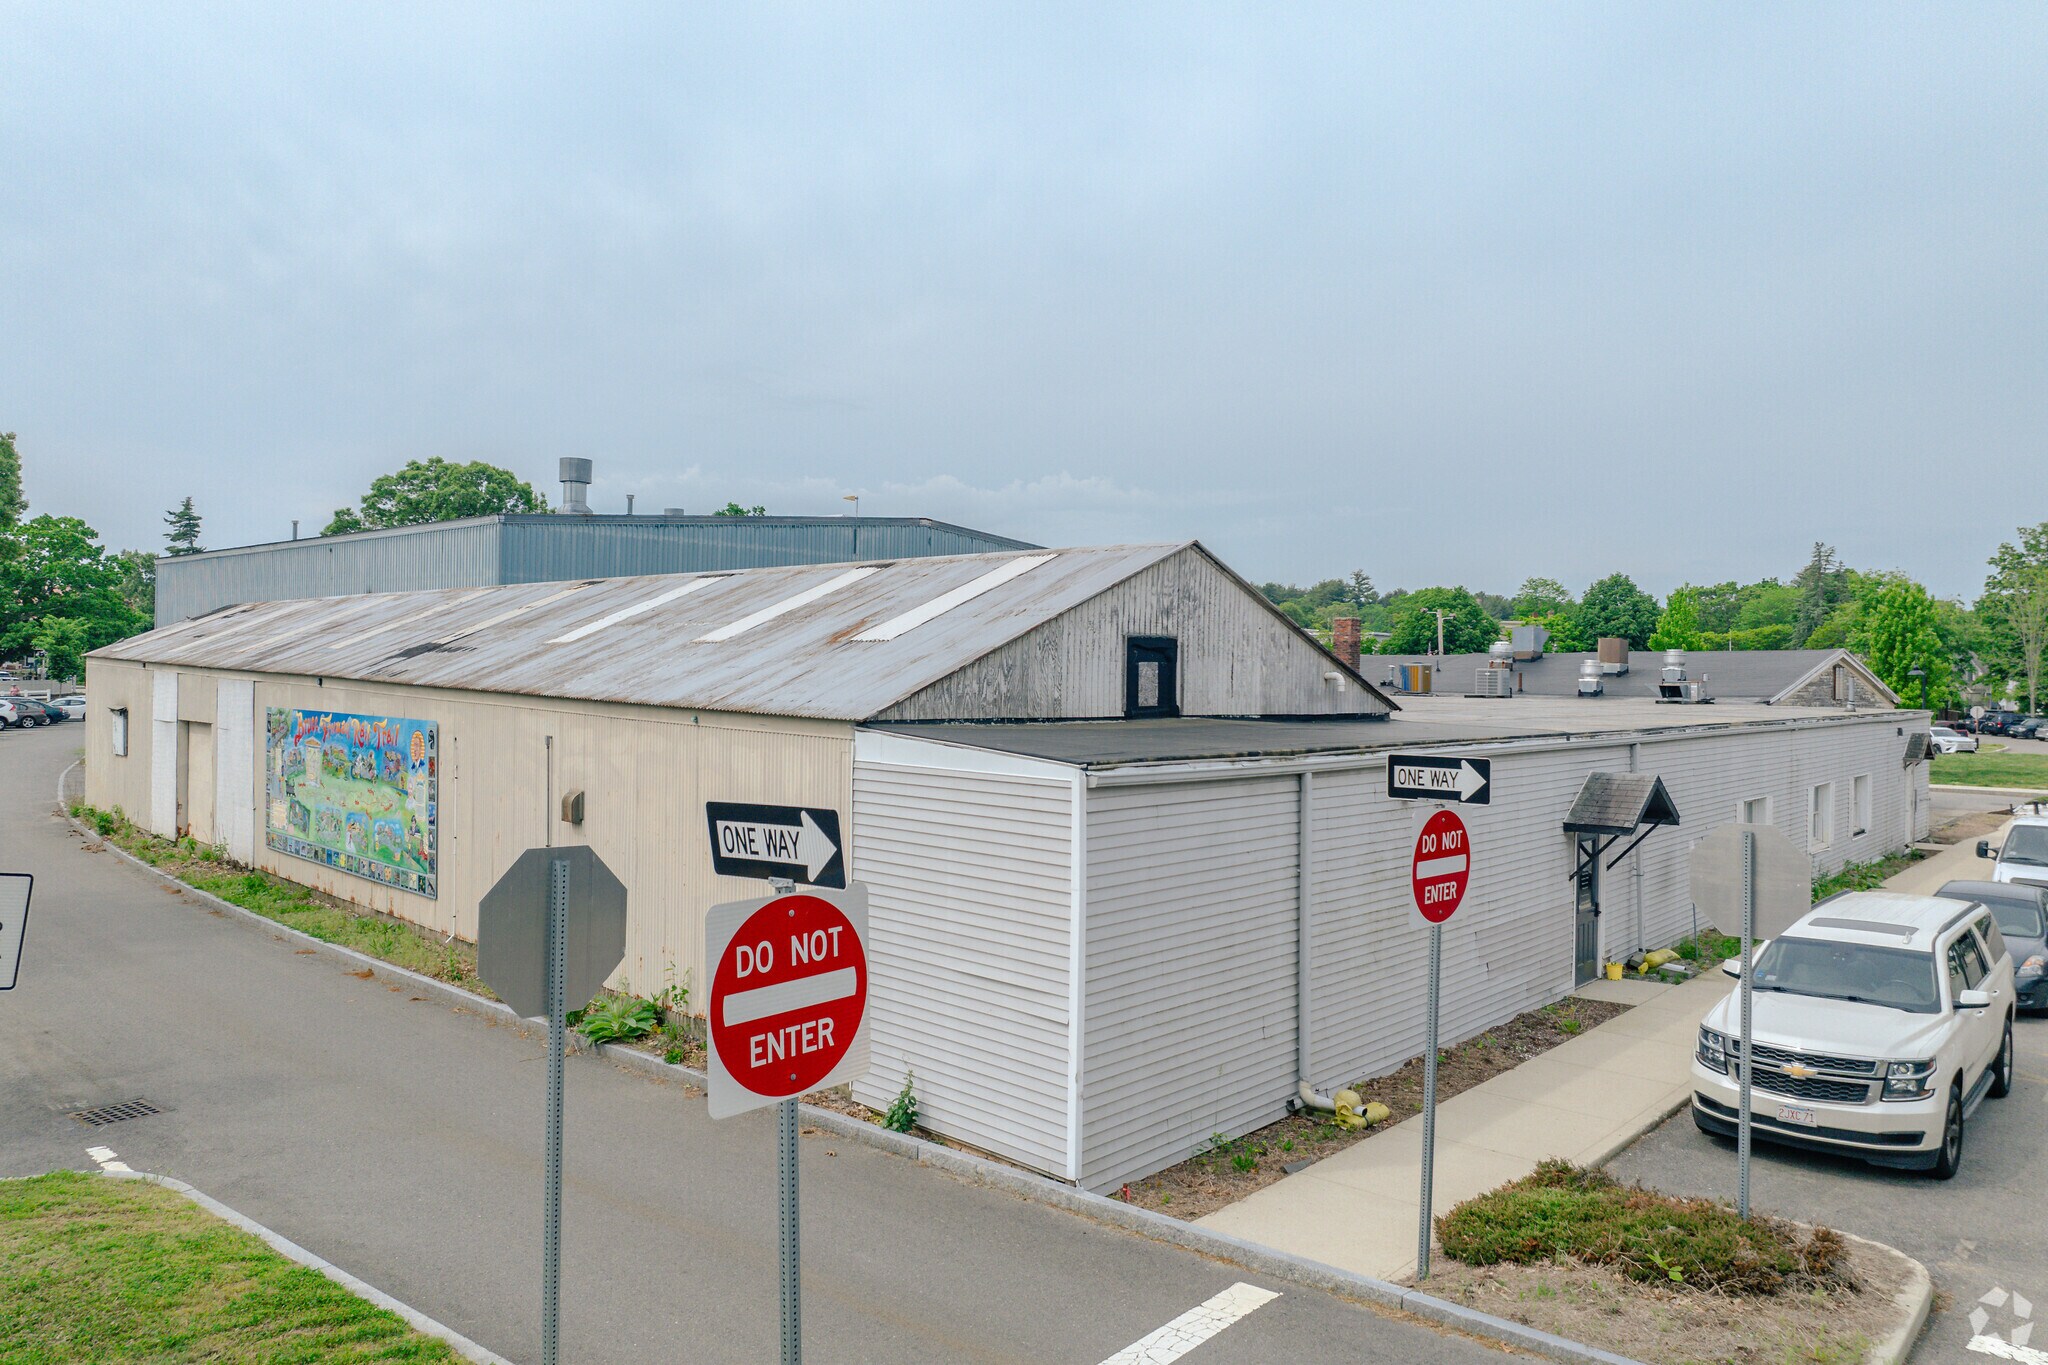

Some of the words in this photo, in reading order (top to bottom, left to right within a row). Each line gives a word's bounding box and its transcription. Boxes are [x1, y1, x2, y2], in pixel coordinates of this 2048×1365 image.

[373, 718, 400, 750] Trail
[1398, 768, 1425, 786] ONE
[1430, 770, 1459, 788] WAY
[723, 824, 759, 855] ONE
[763, 828, 800, 859] WAY
[1422, 834, 1437, 853] DO
[1442, 830, 1463, 850] NOT
[1424, 881, 1457, 905] ENTER
[736, 940, 774, 978] DO
[791, 925, 843, 966] NOT
[750, 1016, 835, 1068] ENTER
